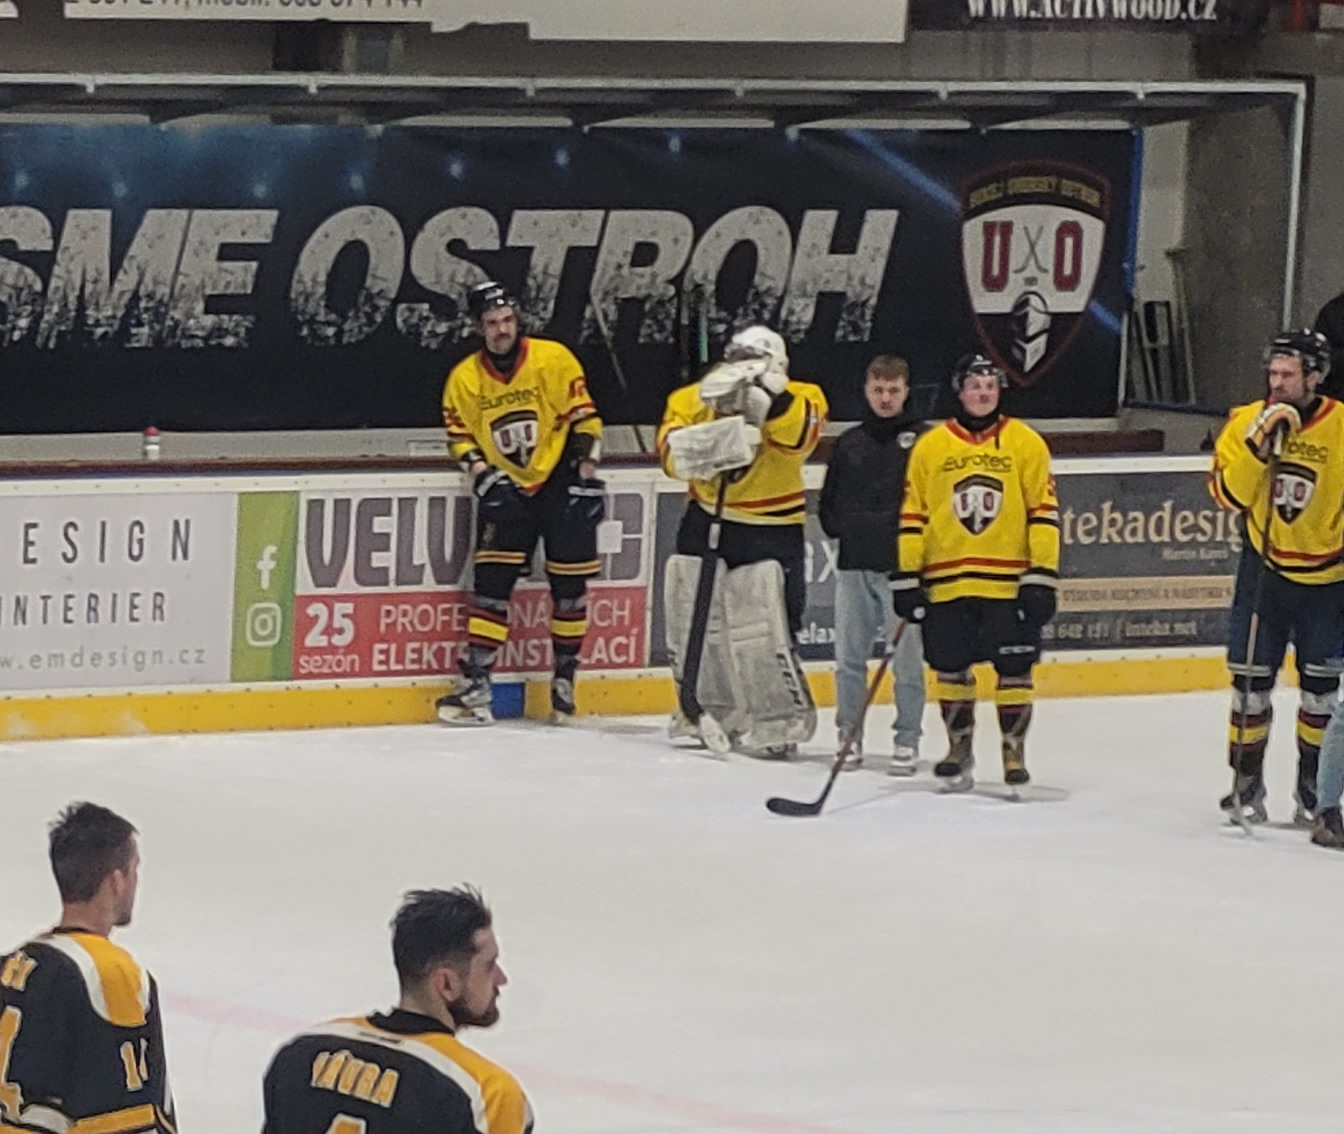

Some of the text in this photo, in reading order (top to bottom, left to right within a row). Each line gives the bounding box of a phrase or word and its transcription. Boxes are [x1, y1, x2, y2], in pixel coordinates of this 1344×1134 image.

[289, 204, 900, 348] OSTROH
[982, 219, 1083, 293] U O
[304, 601, 356, 648] 25
[298, 650, 360, 675] sezón
